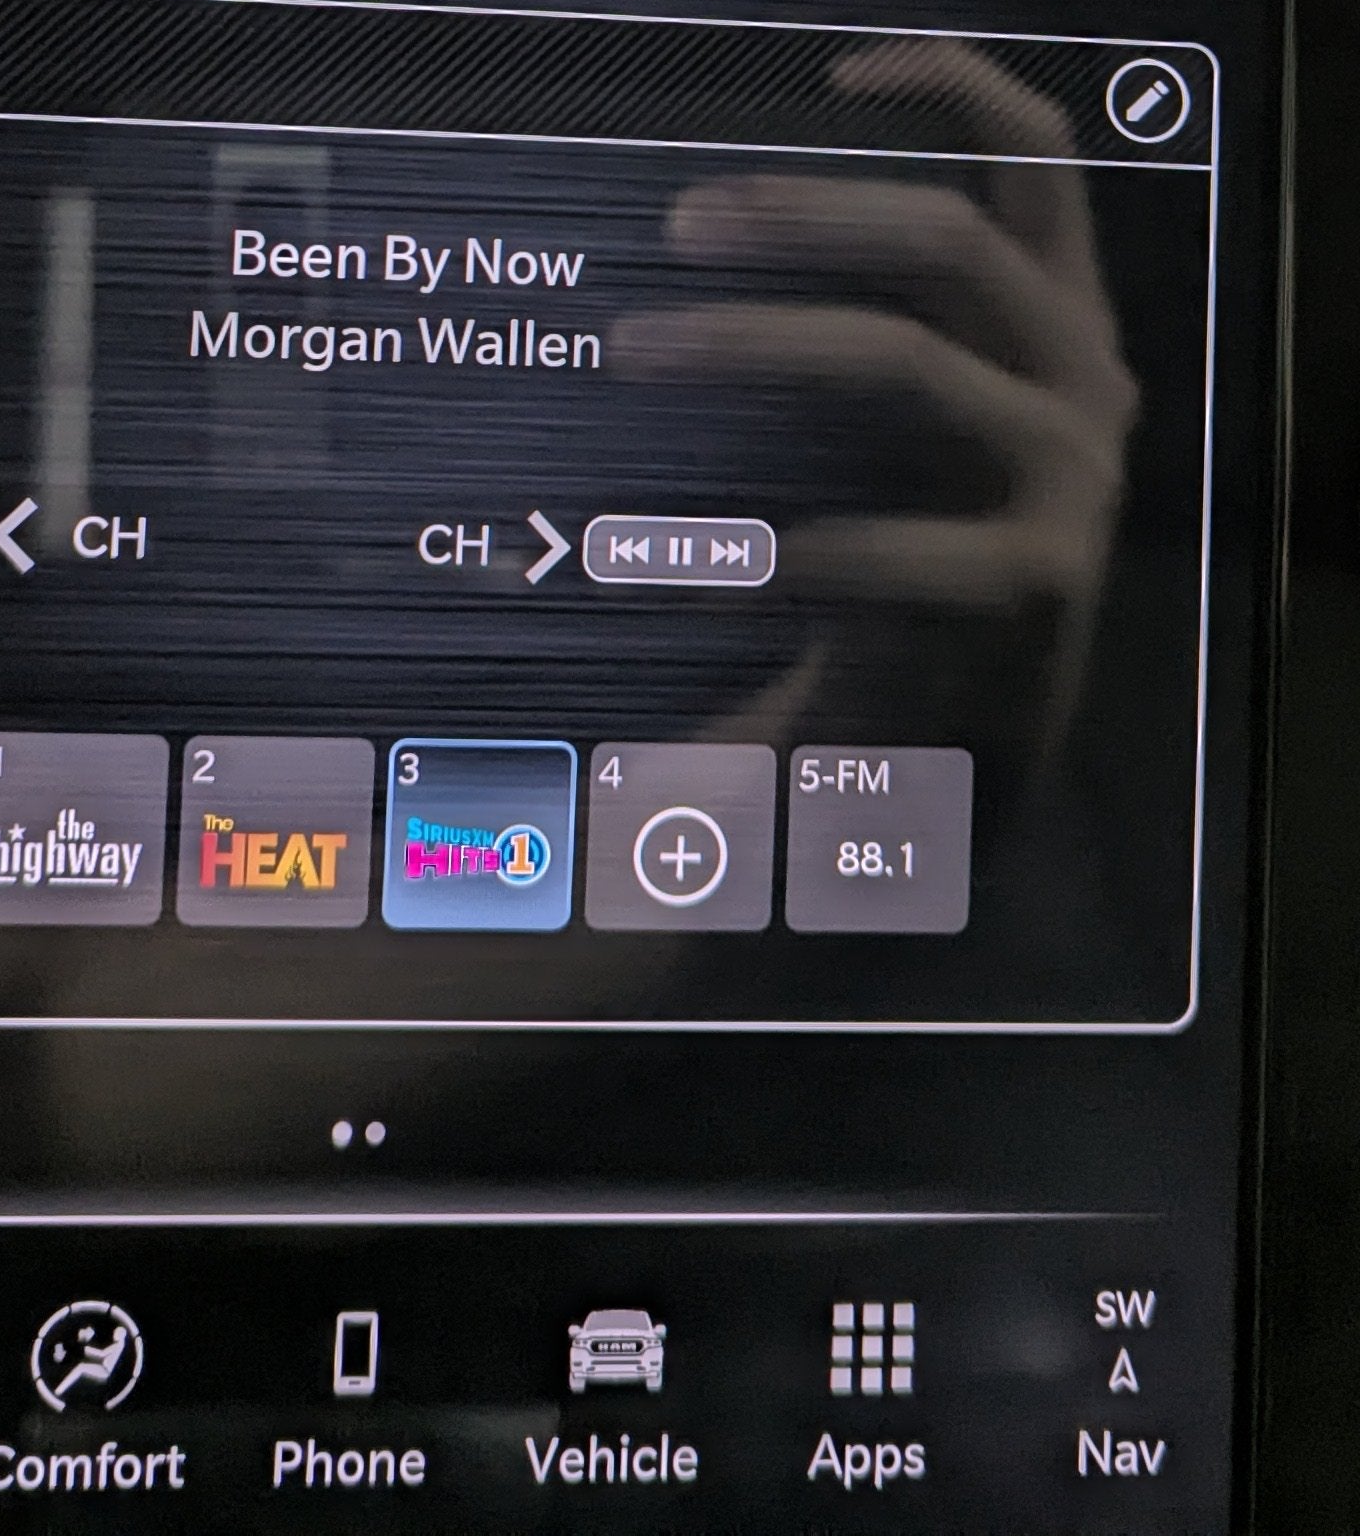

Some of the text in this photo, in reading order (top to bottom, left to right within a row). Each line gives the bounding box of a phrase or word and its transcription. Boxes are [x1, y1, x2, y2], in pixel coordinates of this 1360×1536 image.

[233, 229, 585, 294] Been By Now
[190, 310, 600, 372] Morgan Wallen
[73, 515, 147, 559] CH
[418, 524, 490, 567] CH
[192, 749, 215, 782] 2
[397, 753, 420, 785] 3
[598, 756, 623, 788] 4
[799, 759, 889, 793] 5-FM
[57, 808, 95, 840] the
[202, 812, 236, 834] The
[199, 832, 348, 890] HEAT
[506, 833, 535, 876] 1
[837, 841, 913, 876] 88.1
[1095, 1290, 1155, 1327] SW
[273, 1438, 426, 1487] Phone
[525, 1433, 698, 1483] Vehicle
[807, 1433, 925, 1489] Apps
[1078, 1430, 1165, 1476] Nav
